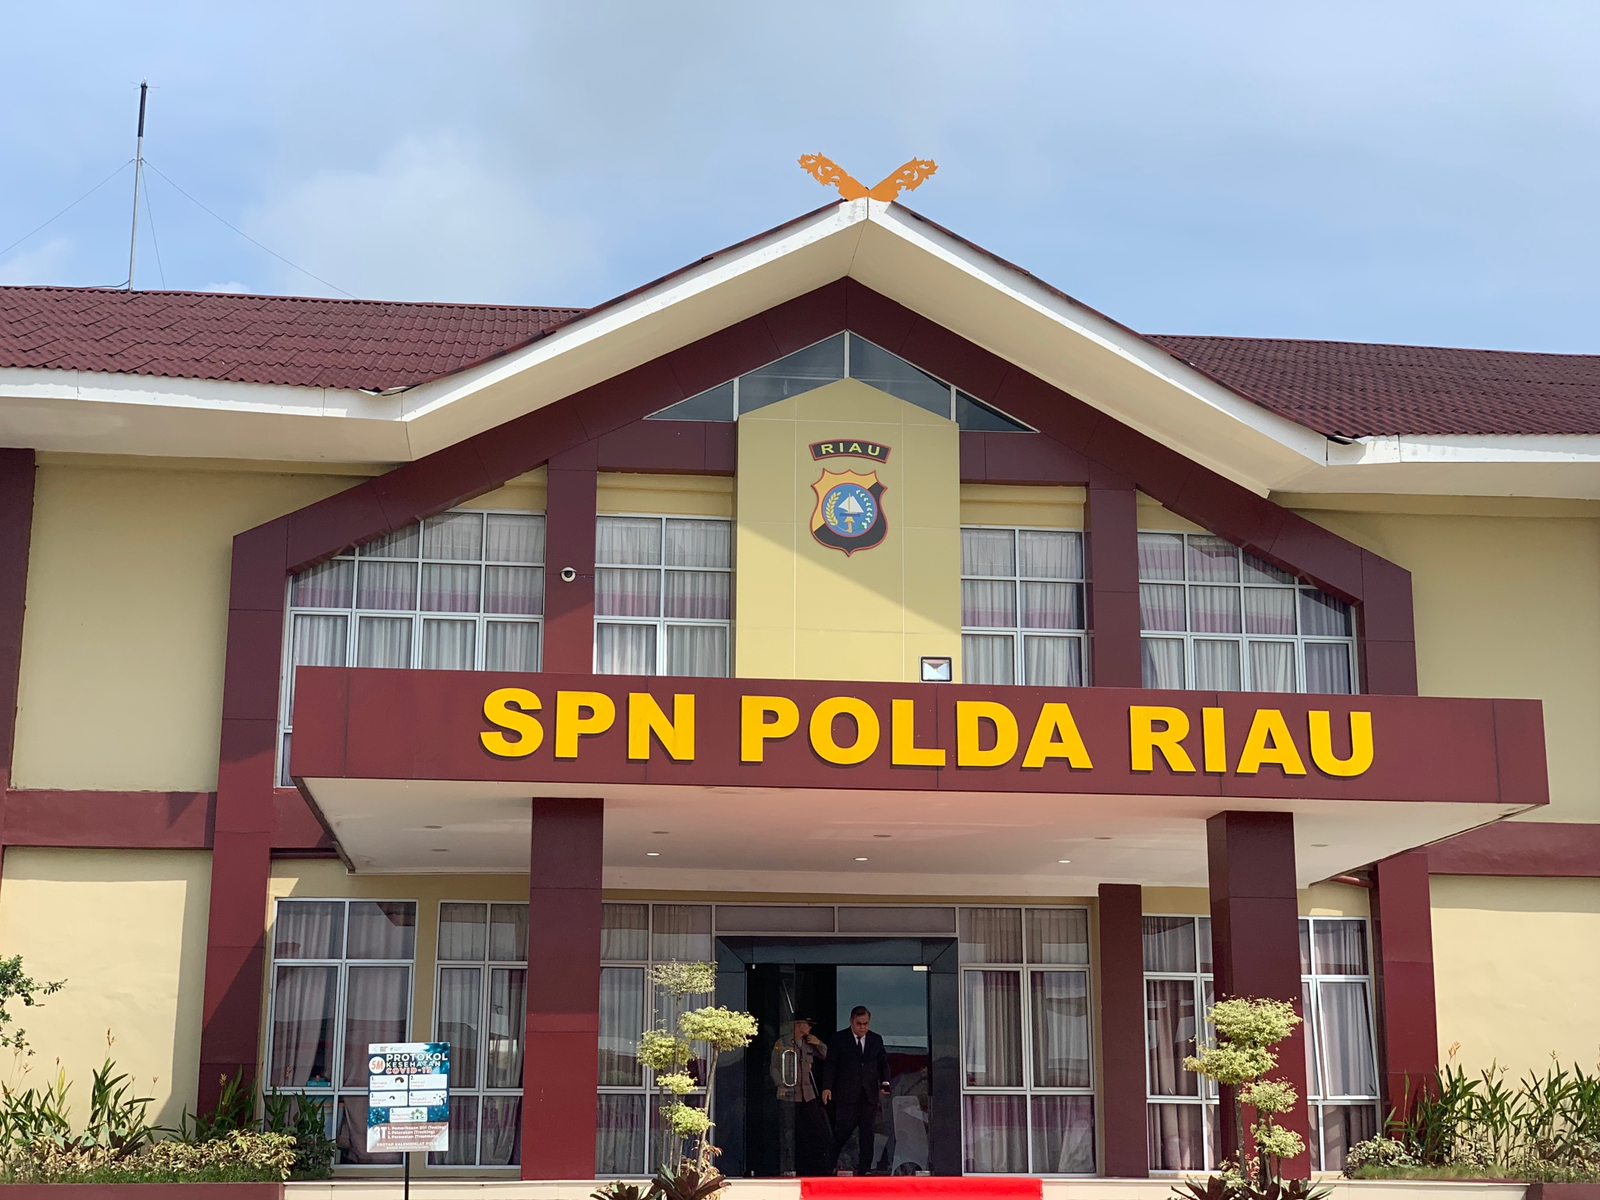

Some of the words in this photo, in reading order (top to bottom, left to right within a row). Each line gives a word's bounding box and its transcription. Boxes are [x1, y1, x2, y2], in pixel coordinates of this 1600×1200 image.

[820, 442, 881, 456] RIAU
[480, 687, 695, 762] SPN
[740, 695, 1094, 770] POLDA
[1129, 705, 1375, 778] RIAU
[386, 1053, 448, 1061] PROTOKOL
[371, 1060, 384, 1072] 5M
[386, 1060, 441, 1068] KESEHATAN
